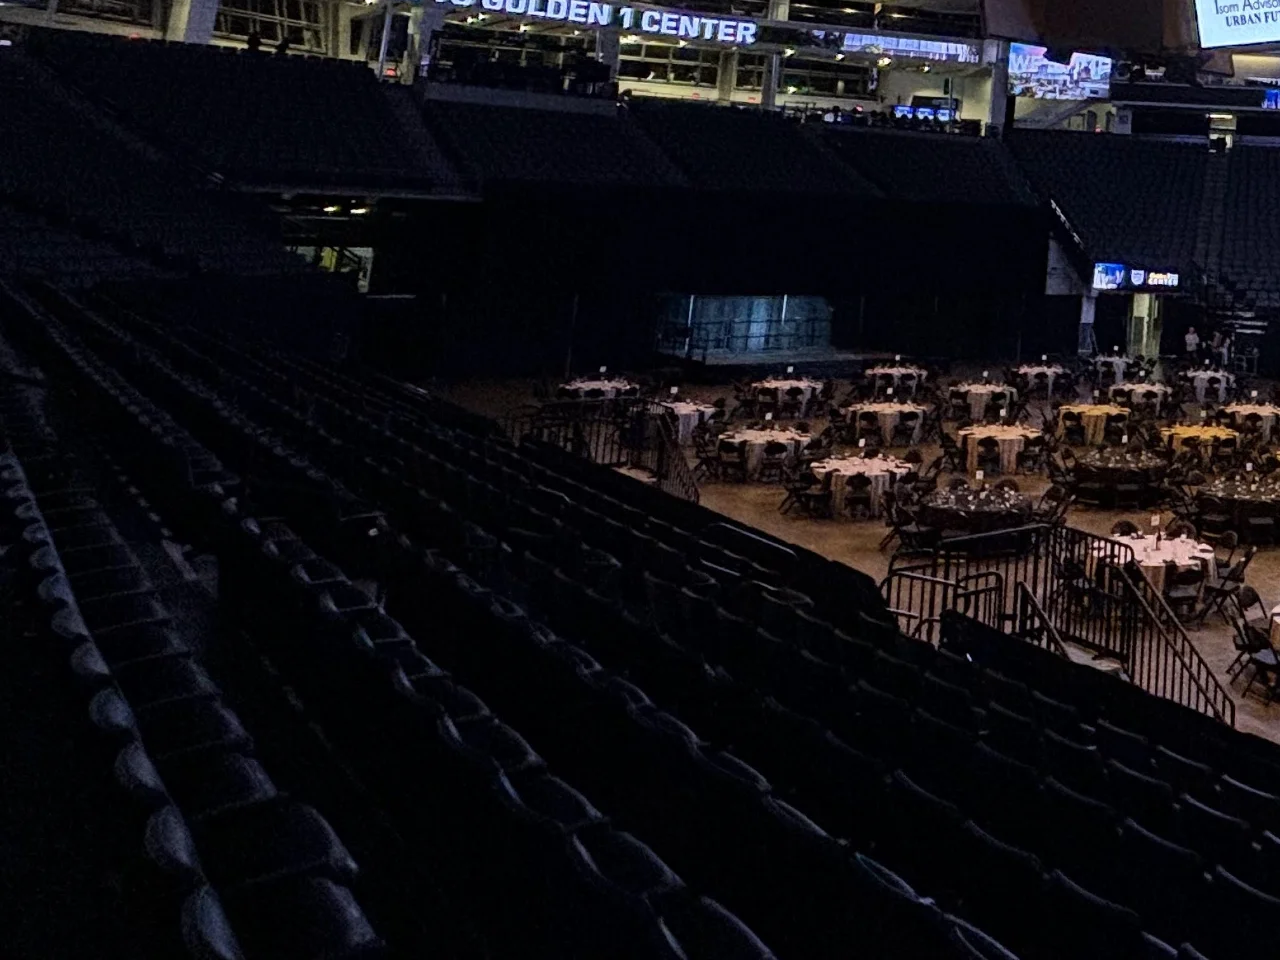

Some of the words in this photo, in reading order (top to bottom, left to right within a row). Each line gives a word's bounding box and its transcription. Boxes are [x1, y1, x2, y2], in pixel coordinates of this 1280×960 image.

[619, 6, 634, 29] 1
[641, 11, 757, 44] CENTER
[1225, 8, 1262, 27] URBAN
